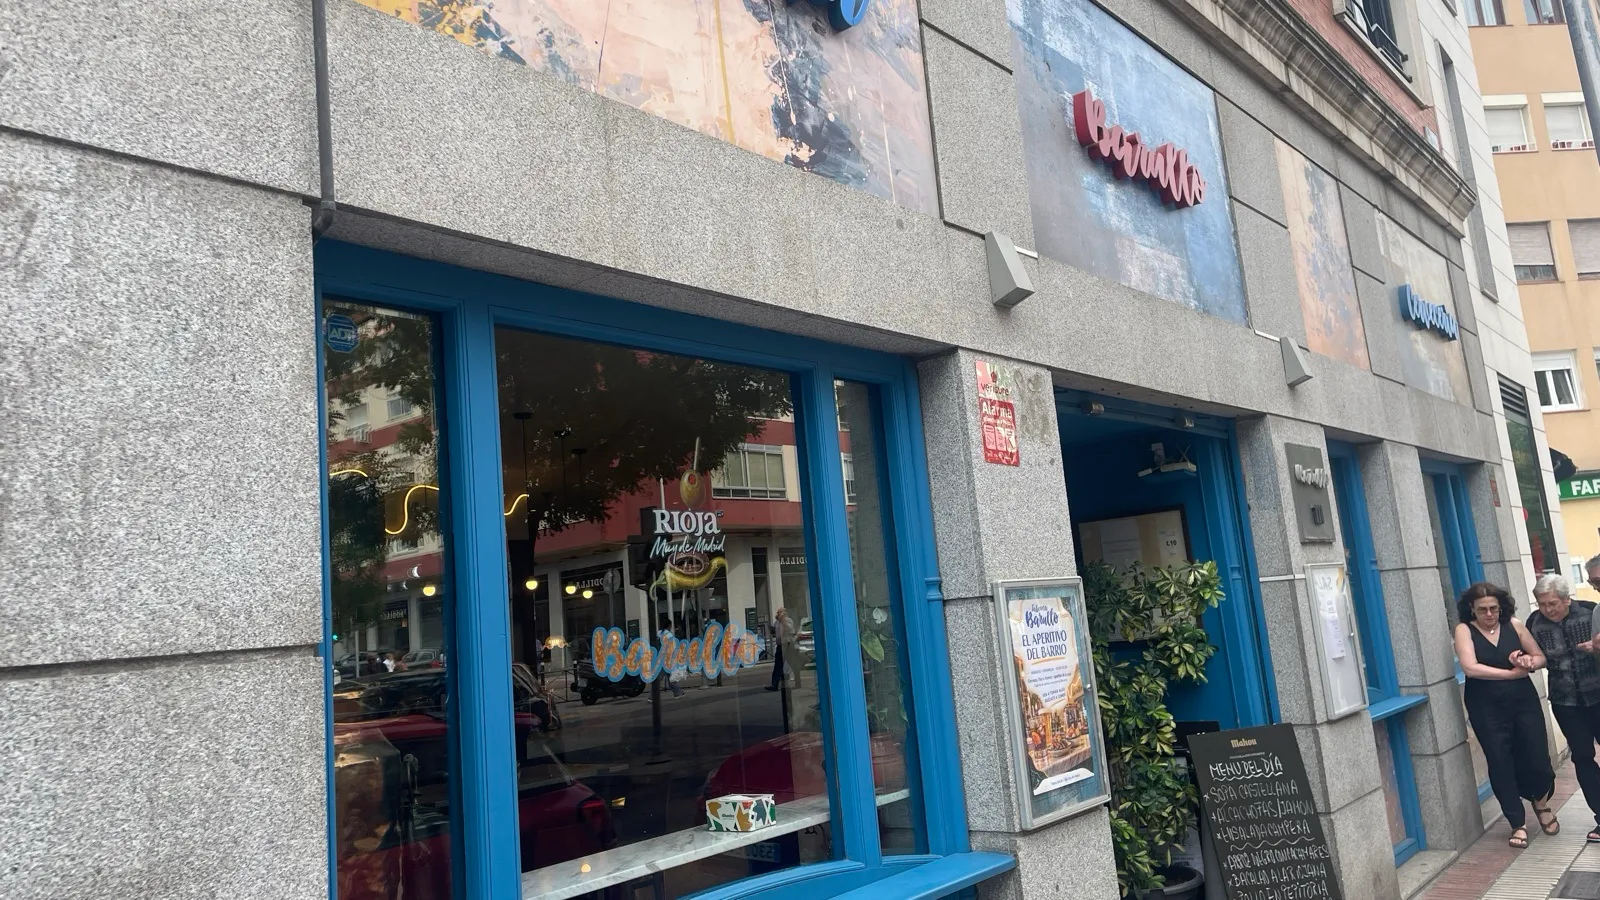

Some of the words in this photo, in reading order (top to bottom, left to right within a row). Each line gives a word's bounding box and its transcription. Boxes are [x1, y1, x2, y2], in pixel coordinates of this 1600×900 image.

[1073, 88, 1207, 209] Barullo
[982, 401, 1012, 418] Alarma
[649, 536, 679, 565] Muy
[679, 535, 693, 553] de
[692, 534, 726, 555] Madrid
[1025, 608, 1059, 629] Barullo
[1021, 634, 1032, 647] EL
[1032, 629, 1068, 645] APERITIVO
[592, 621, 763, 683] Barullo
[1026, 647, 1041, 661] DEL
[1041, 643, 1067, 659] BARRIO
[1231, 738, 1257, 748] Mahou
[1209, 761, 1241, 778] MENU
[1240, 760, 1262, 775] DEL
[1261, 752, 1283, 773] DÍA
[1209, 784, 1238, 804] SOPA
[1238, 779, 1299, 800] CASTELLANA
[1220, 822, 1267, 843] ENSALADA
[1267, 818, 1311, 838] CAMPERA
[1231, 869, 1270, 888] BACALAO
[1280, 878, 1330, 900] PEPITORIA
